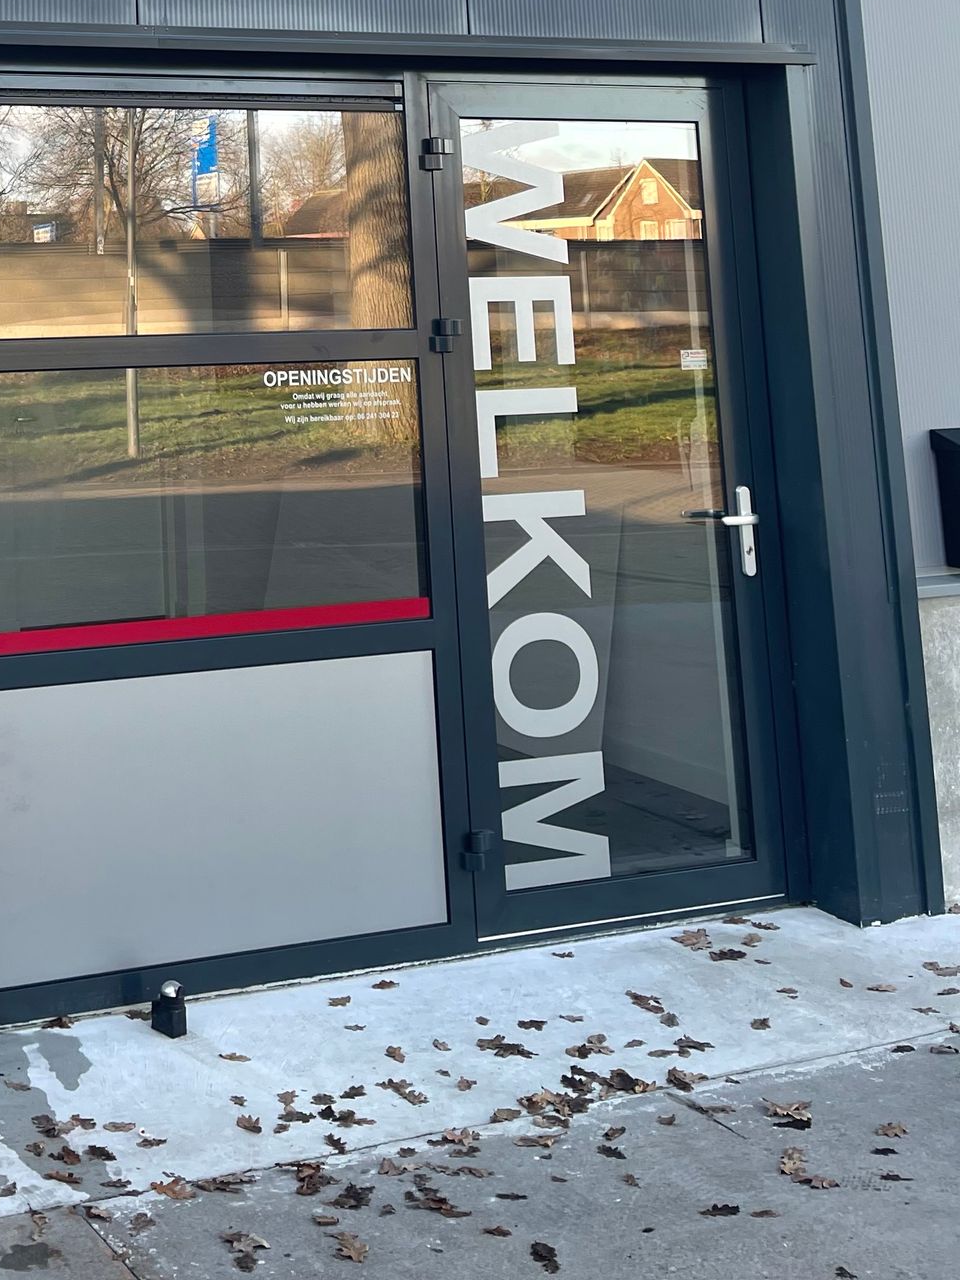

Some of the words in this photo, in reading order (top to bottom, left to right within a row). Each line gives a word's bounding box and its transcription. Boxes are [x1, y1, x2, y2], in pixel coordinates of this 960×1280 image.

[263, 367, 412, 387] OPENINGSTIJDEN
[292, 393, 315, 401] Omdat
[315, 392, 325, 401] wij
[326, 392, 345, 400] graag
[303, 401, 327, 409] hebben
[328, 400, 351, 408] werken
[284, 415, 296, 425] Wij
[297, 415, 309, 424] zijn
[309, 413, 344, 422] bereikbaar
[461, 122, 612, 891] WELKOM
